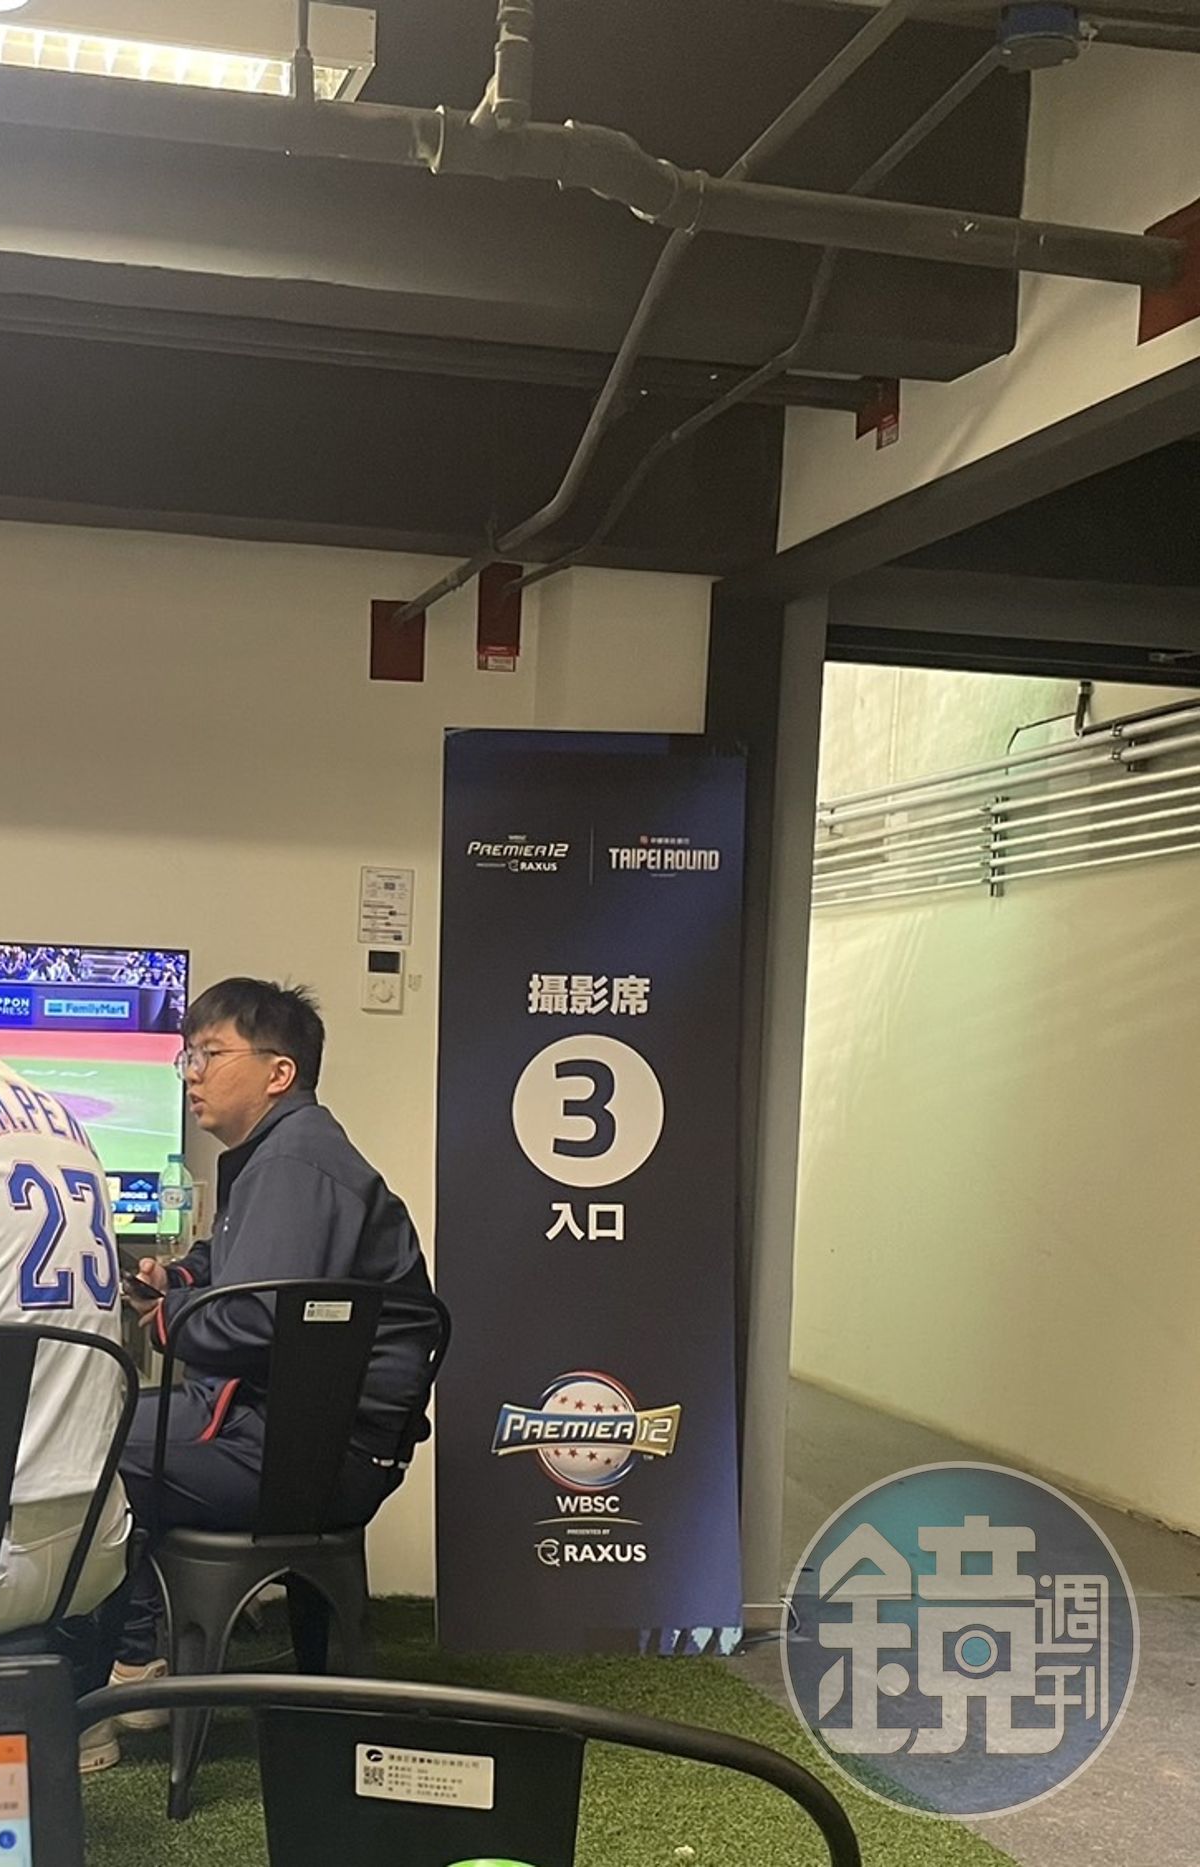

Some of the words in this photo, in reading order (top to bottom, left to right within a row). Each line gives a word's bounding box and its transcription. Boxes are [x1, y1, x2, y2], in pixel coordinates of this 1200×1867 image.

[519, 861, 558, 872] RAXUS
[608, 847, 662, 870] TAIPEI
[663, 848, 720, 871] ROUND
[528, 973, 651, 1016] 攝影席
[64, 1003, 127, 1016] FamilyMart
[552, 1059, 617, 1158] 3
[545, 1202, 625, 1241] 入口
[6, 1160, 119, 1311] 23
[502, 1413, 634, 1442] PREMIER
[639, 1417, 673, 1443] 12
[556, 1496, 620, 1513] WBSC
[564, 1544, 648, 1562] RAXUS
